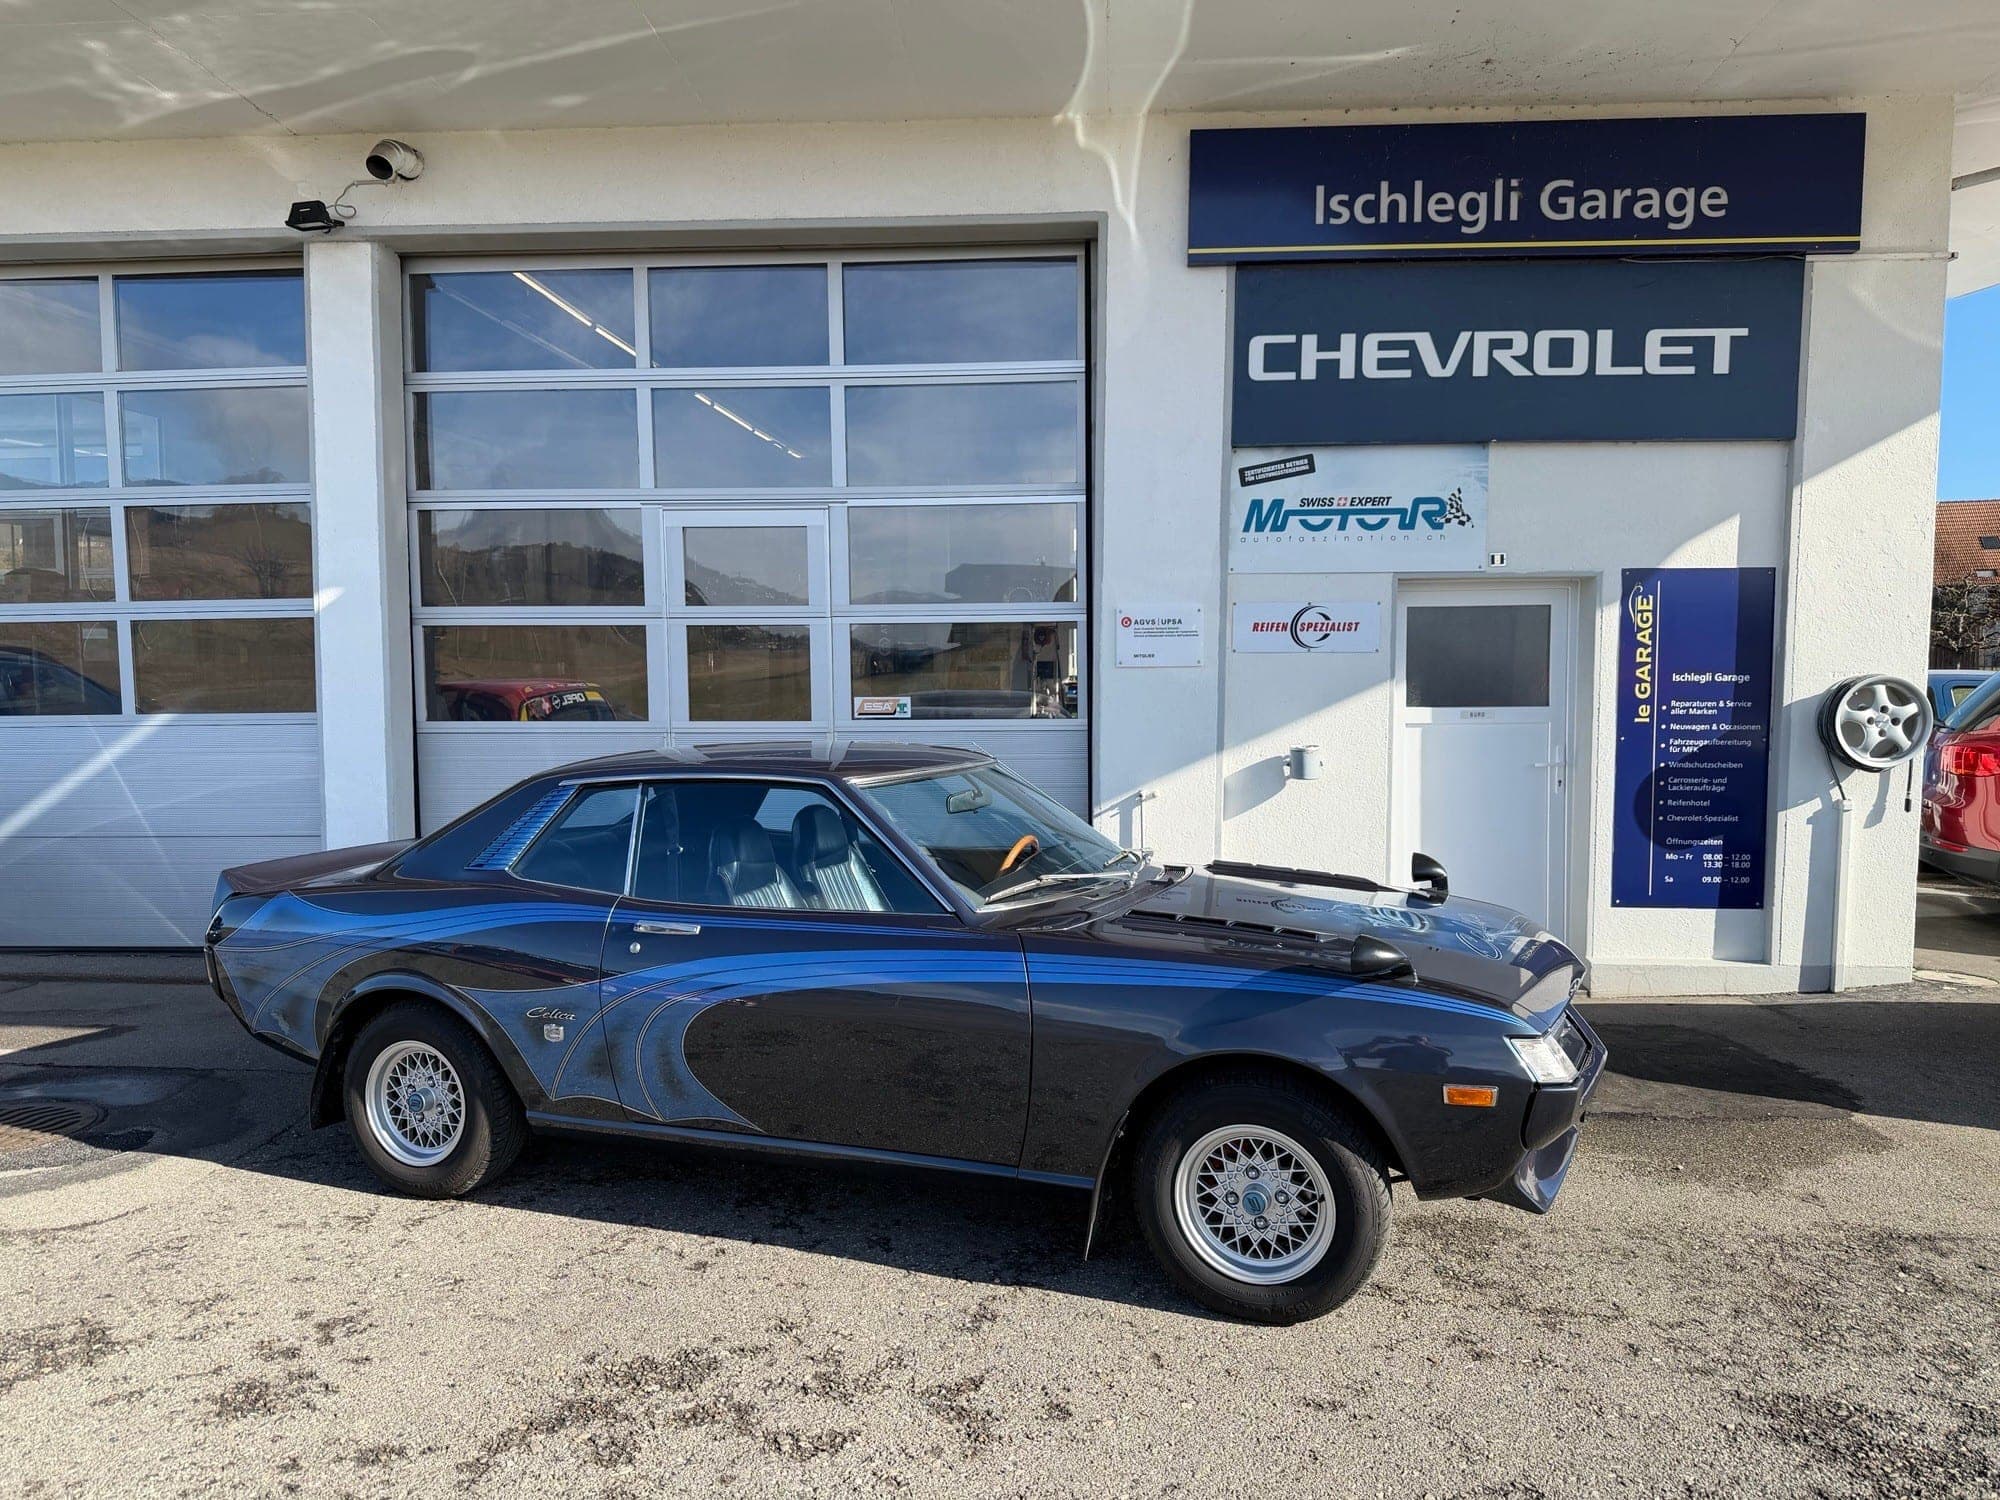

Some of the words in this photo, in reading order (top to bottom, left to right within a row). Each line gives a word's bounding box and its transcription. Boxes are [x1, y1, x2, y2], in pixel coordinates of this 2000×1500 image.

[1314, 179, 1521, 233] Ischlegli
[1539, 178, 1729, 231] Garage
[1248, 327, 1749, 381] CHEVROLET
[1299, 497, 1334, 508] SWISS
[1350, 496, 1392, 507] EXPERT
[1242, 496, 1448, 533] MOTOR
[1252, 621, 1289, 633] REIFEN
[1299, 621, 1361, 632] SPEZIALIST
[1634, 594, 1653, 699] GARAGE
[1672, 673, 1712, 684] Ischlegli
[1714, 673, 1750, 684] Garage
[1670, 700, 1717, 709] Reparaturen
[1634, 704, 1650, 723] le
[1670, 723, 1710, 731] Neuwagen
[1719, 723, 1761, 731] Occasionen
[1669, 738, 1752, 747] Fahrzeugaufbereitung
[1668, 761, 1743, 769] Windschutzscheiben
[1668, 776, 1711, 784] Carrosserie-
[1668, 784, 1726, 792] Lackieraufträge
[1667, 799, 1710, 807] Reifenhotel
[1666, 814, 1739, 822] Chevrolet-Spezialist
[1666, 837, 1723, 846] Öffnungszeiten
[526, 1006, 576, 1020] Celica
